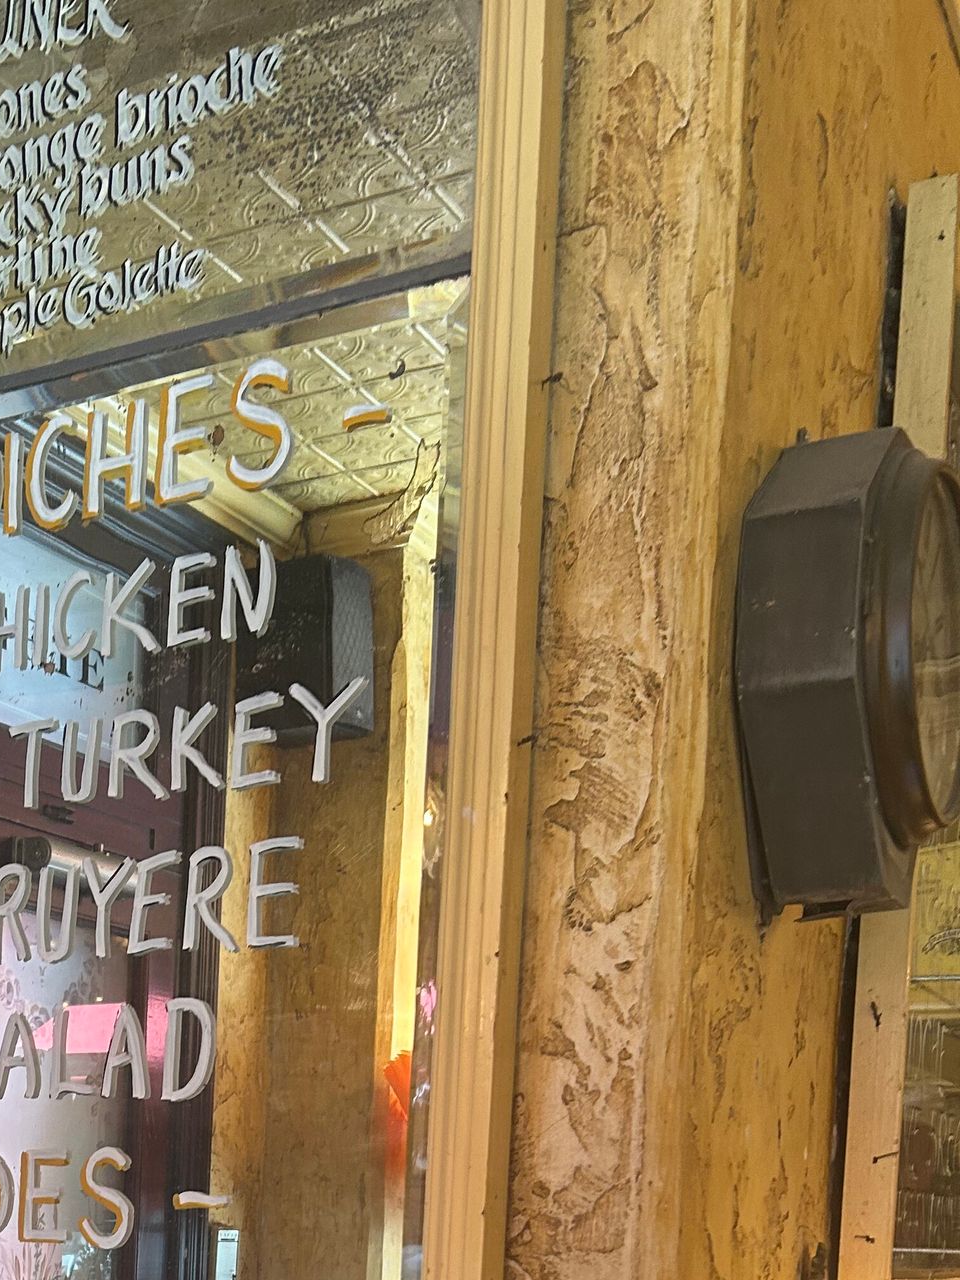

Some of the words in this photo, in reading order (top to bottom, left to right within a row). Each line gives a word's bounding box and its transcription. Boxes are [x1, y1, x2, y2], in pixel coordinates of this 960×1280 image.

[115, 44, 283, 147] brioche
[78, 134, 194, 220] buns
[62, 240, 209, 329] Galette
[10, 675, 370, 809] TURKEY
